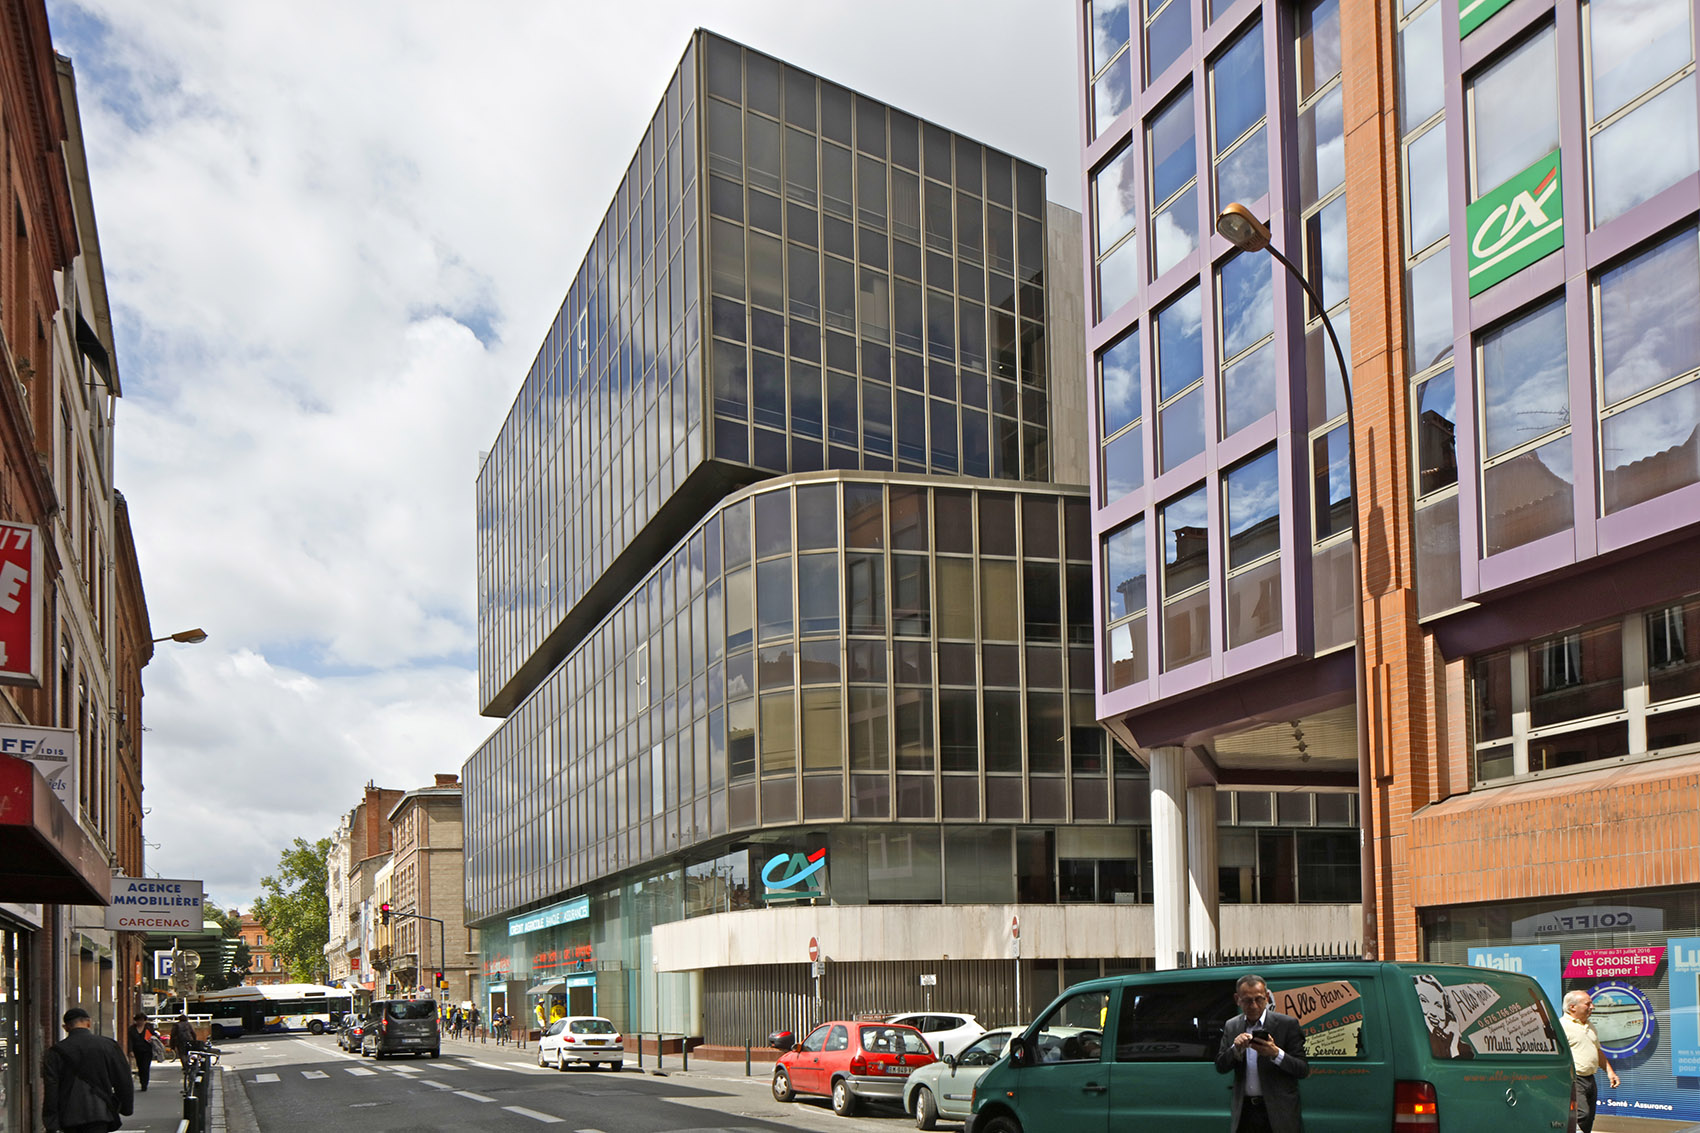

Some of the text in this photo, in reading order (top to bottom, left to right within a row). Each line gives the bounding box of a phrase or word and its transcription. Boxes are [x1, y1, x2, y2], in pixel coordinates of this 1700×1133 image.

[128, 883, 181, 893] AGENCE
[111, 895, 199, 906] IMMOBILIÈRE
[119, 918, 190, 927] CARCENAC
[1475, 953, 1522, 972] Alain
[1572, 954, 1656, 967] UNE CROISIÈRE
[1587, 967, 1593, 975] à
[1596, 967, 1632, 977] gagner
[1284, 992, 1316, 1019] Allo
[1313, 984, 1344, 1009] Jean
[1451, 989, 1479, 1022] Allo
[1484, 1035, 1549, 1053] Multi Services
[1313, 1046, 1347, 1056] Services
[1607, 1099, 1627, 1107] Santé
[1634, 1101, 1673, 1110] Assurance
